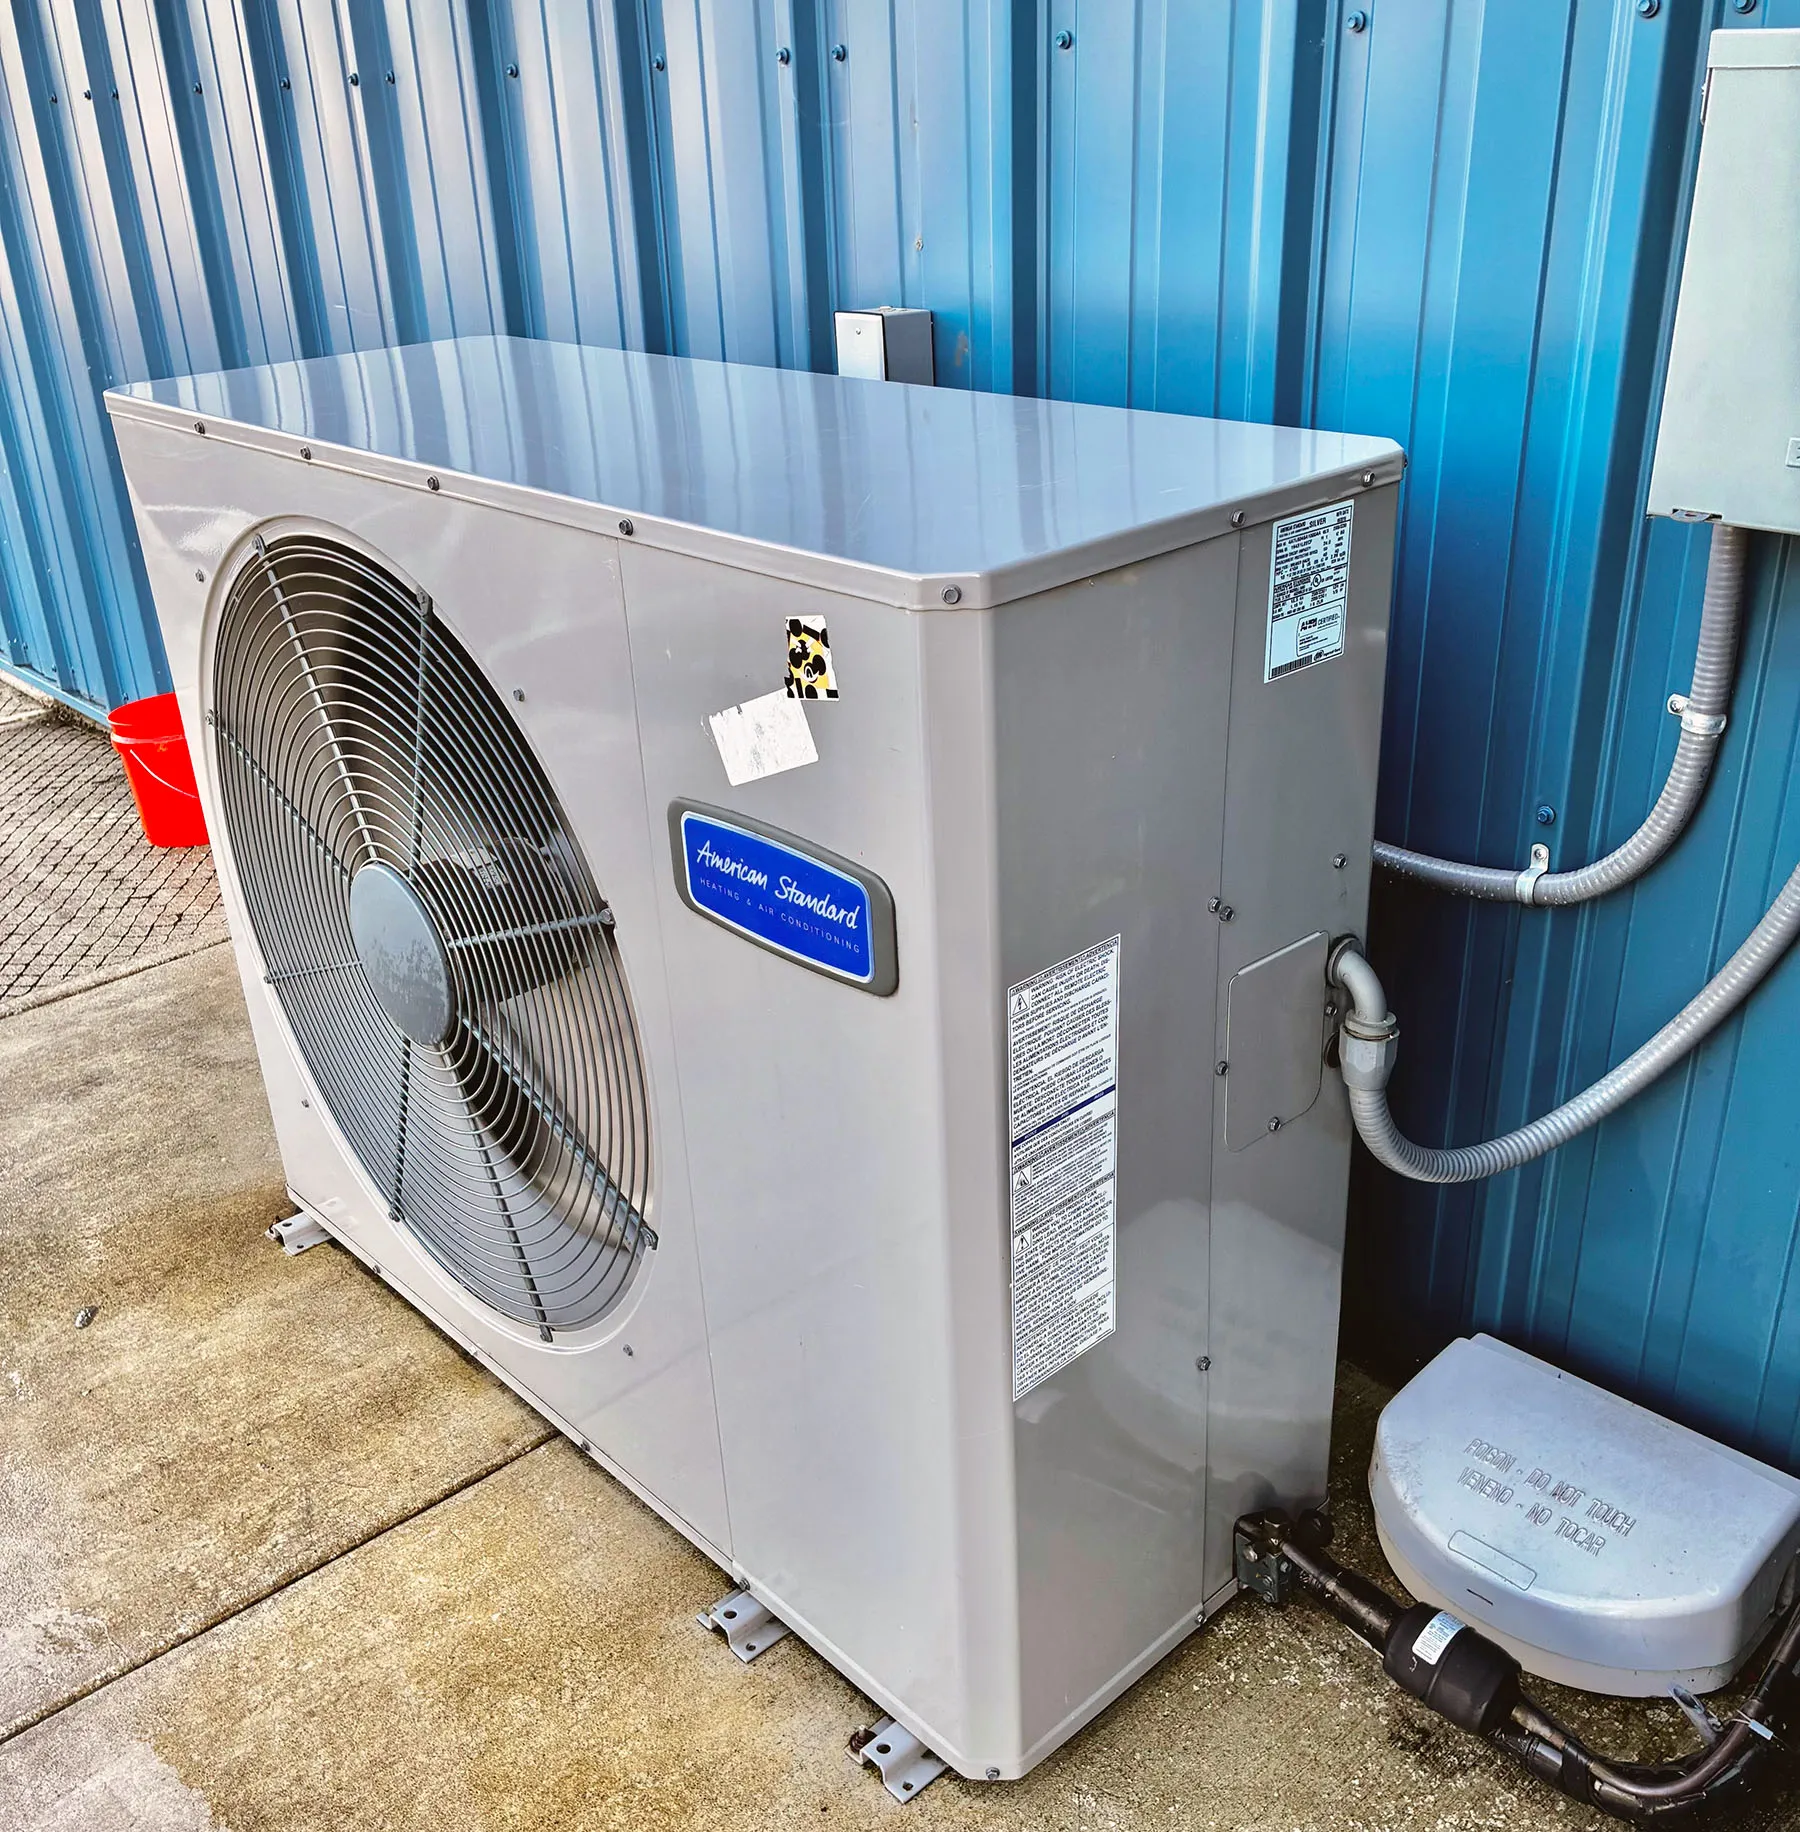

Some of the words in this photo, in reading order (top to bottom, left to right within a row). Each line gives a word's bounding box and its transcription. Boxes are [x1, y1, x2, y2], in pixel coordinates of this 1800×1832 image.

[1309, 517, 1327, 528] SILVER
[697, 839, 768, 890] American
[774, 876, 861, 929] Standard
[700, 878, 740, 901] HEATING
[758, 904, 774, 916] AIR
[780, 913, 860, 953] CONDITIONING
[1457, 1466, 1514, 1505] VENENO
[1525, 1501, 1553, 1526] NO
[1554, 1517, 1606, 1557] TOCAR
[1464, 1438, 1517, 1473] POISON
[1524, 1467, 1552, 1491] DO
[1550, 1480, 1586, 1508] NOT
[1585, 1498, 1636, 1537] TOUCH
